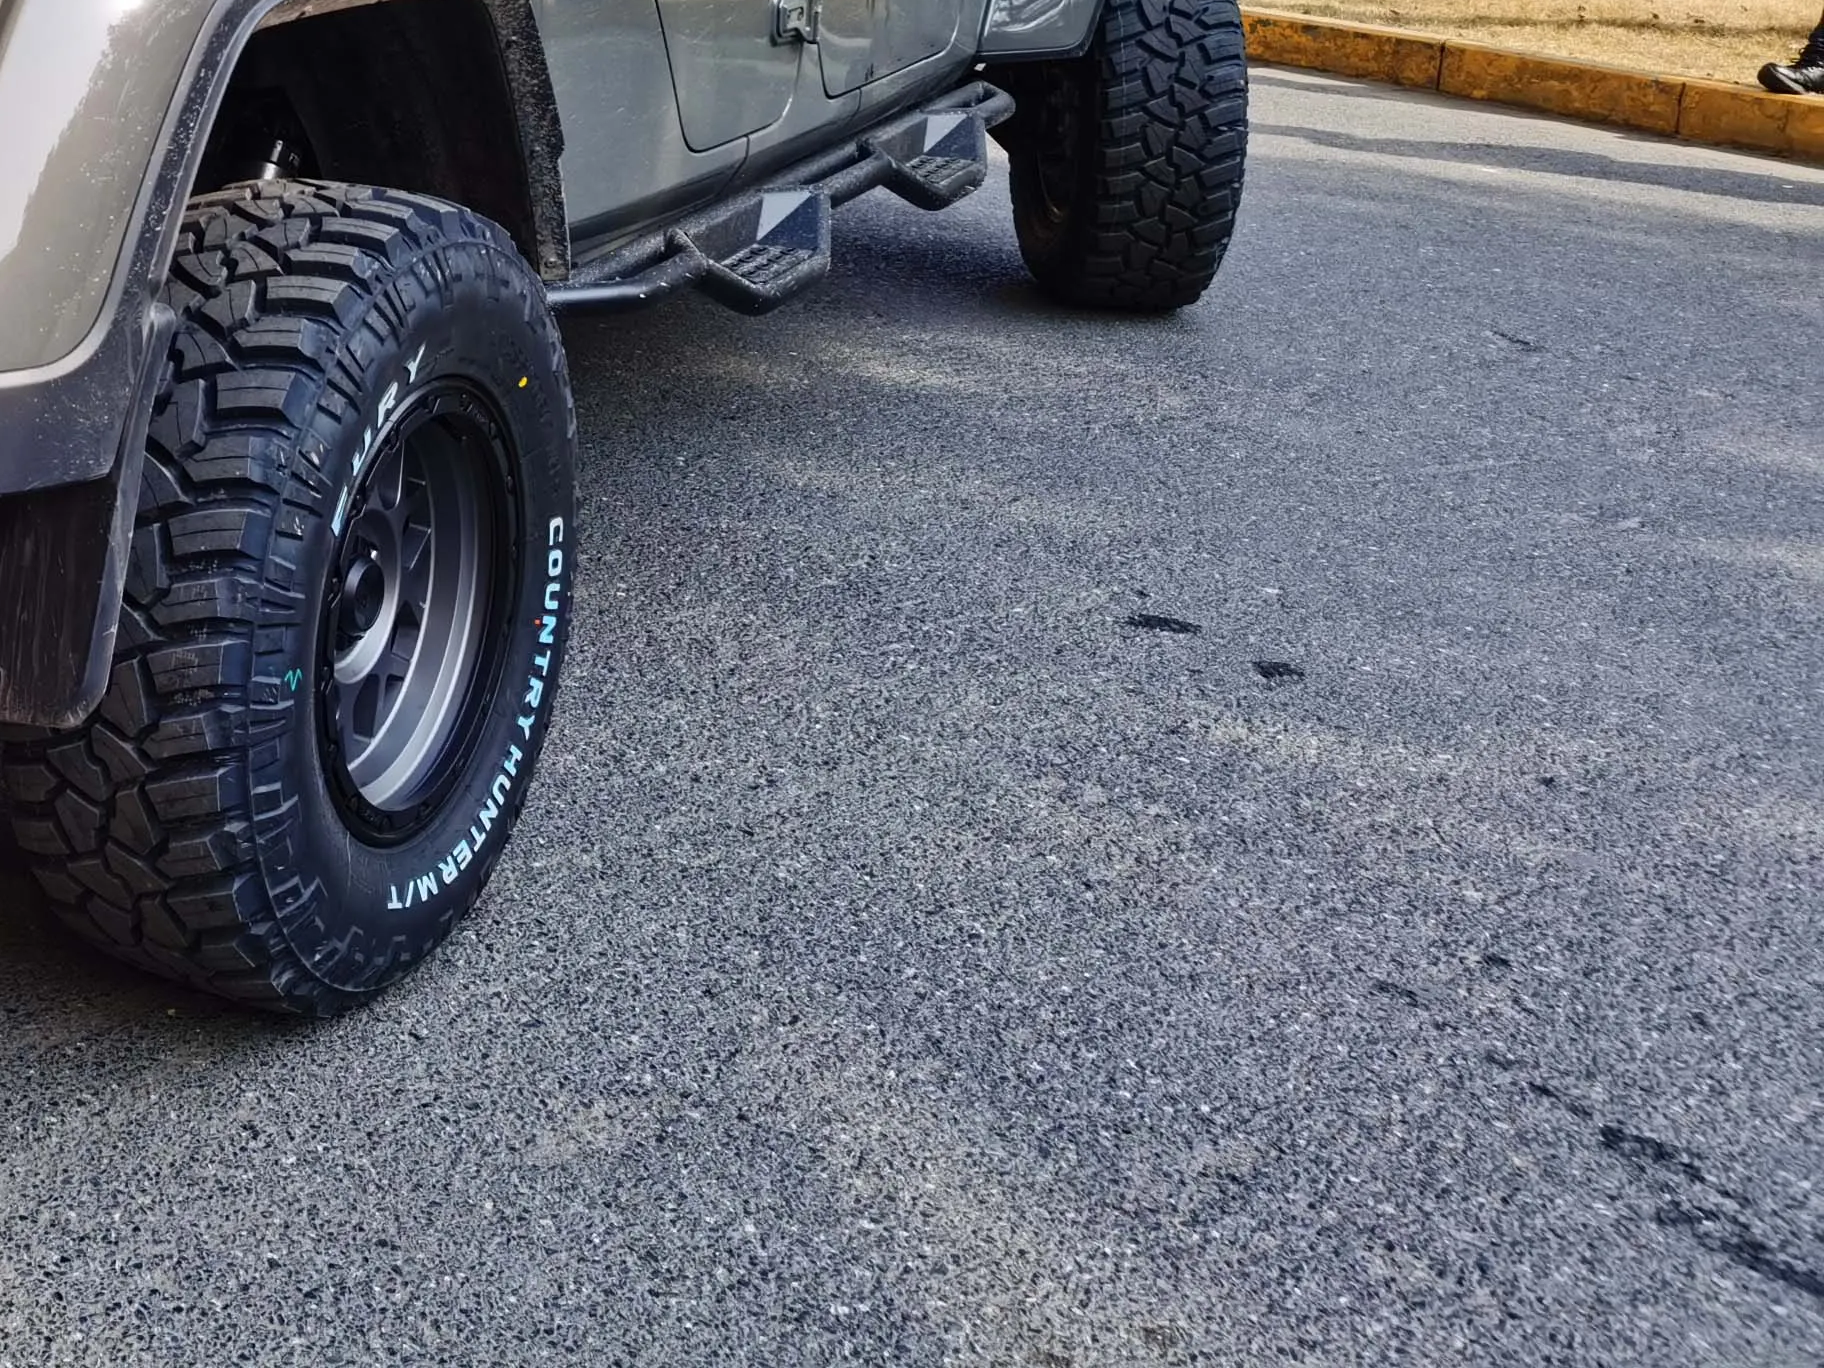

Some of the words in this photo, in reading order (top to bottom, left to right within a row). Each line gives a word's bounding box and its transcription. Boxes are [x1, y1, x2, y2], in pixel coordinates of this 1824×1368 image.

[516, 516, 564, 741] COUNTRY
[437, 744, 524, 886] HUNTER
[386, 874, 440, 910] M/T
